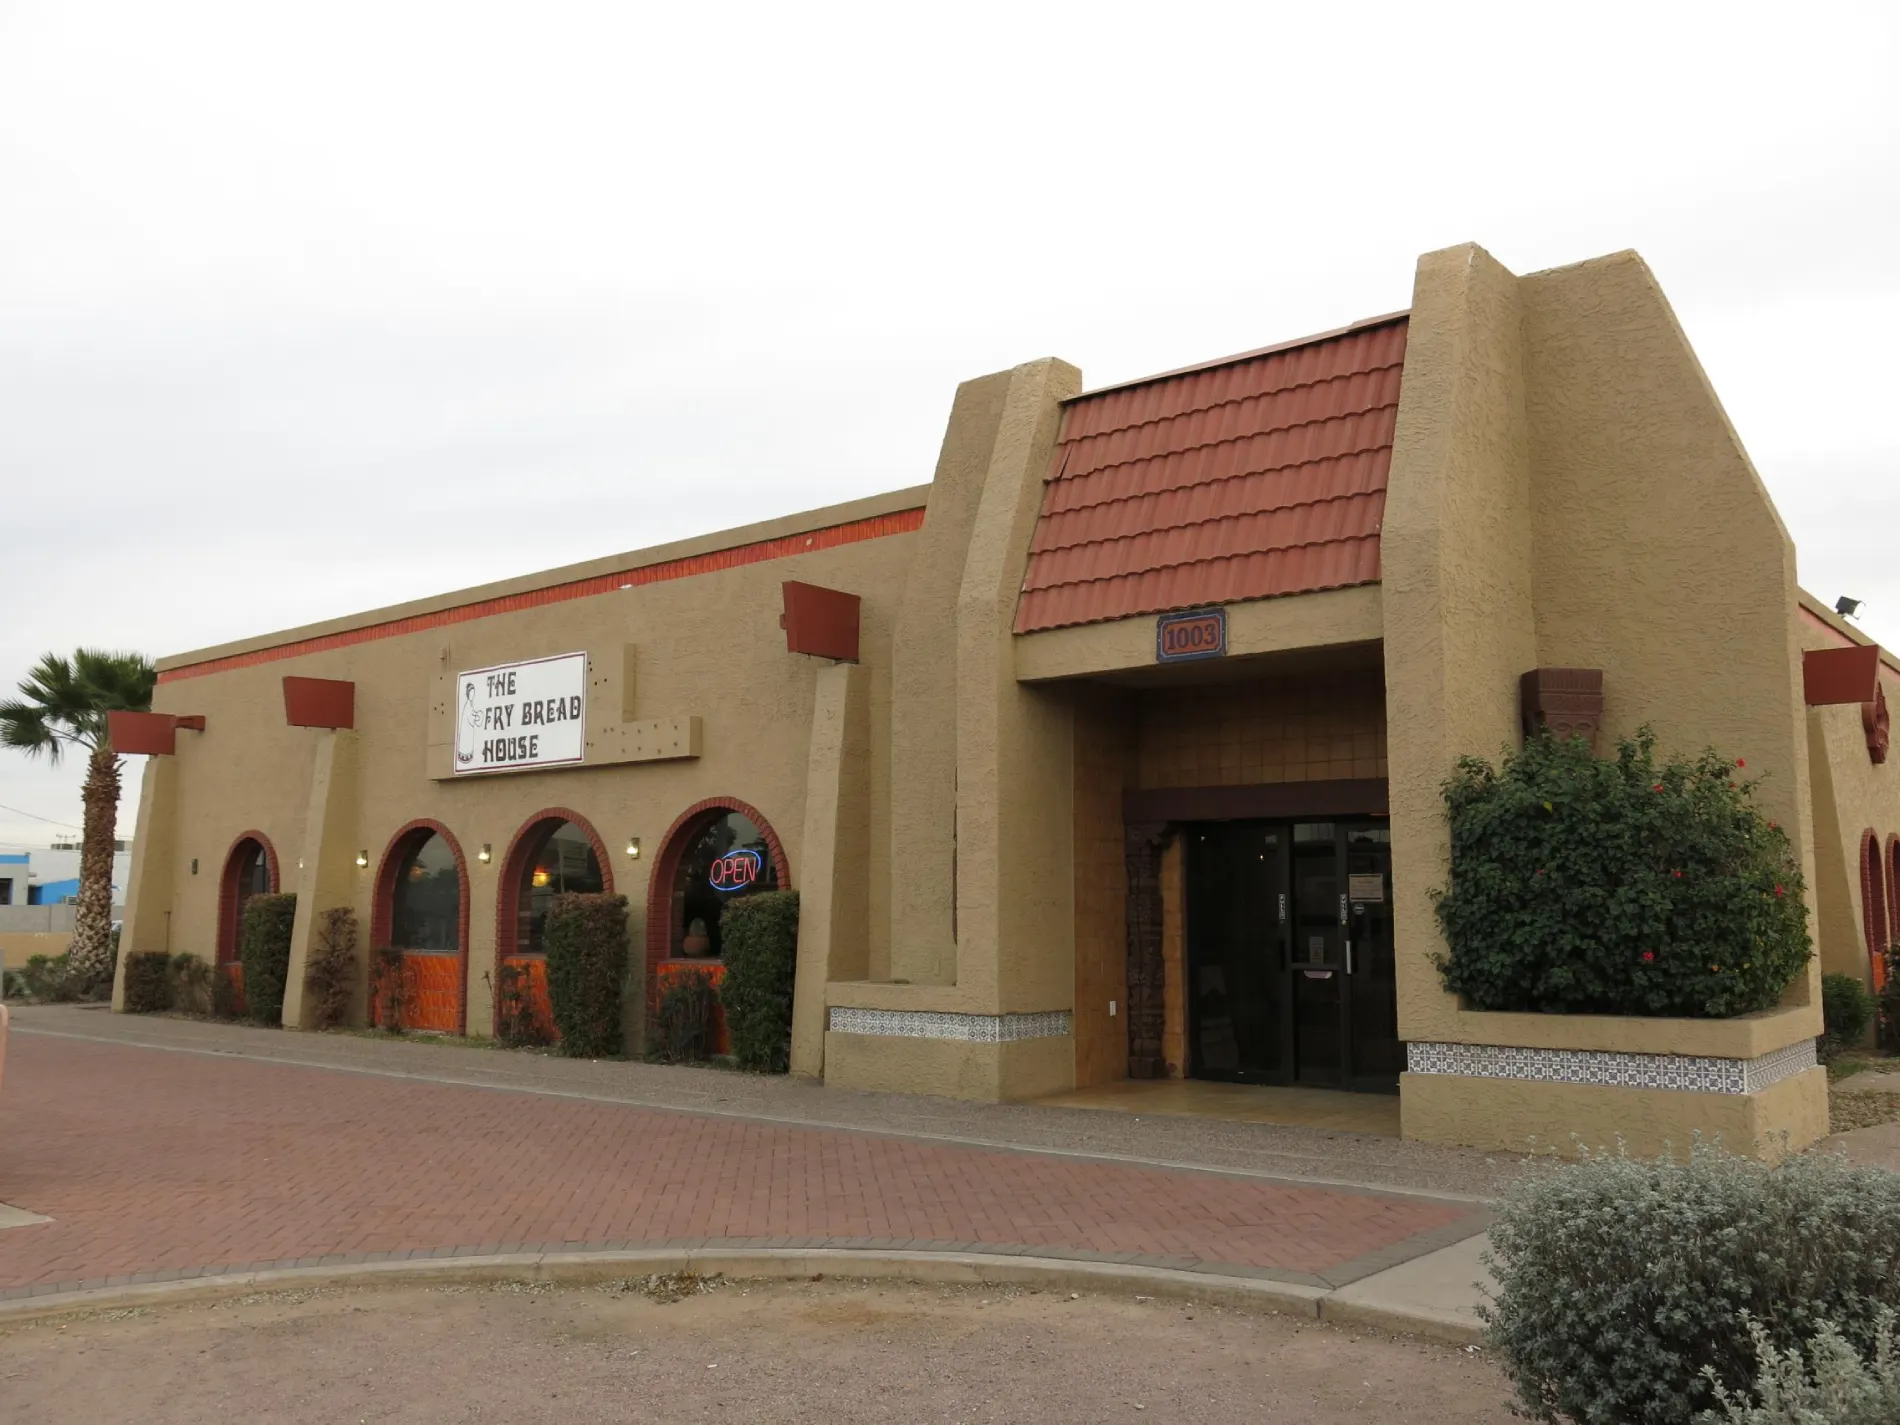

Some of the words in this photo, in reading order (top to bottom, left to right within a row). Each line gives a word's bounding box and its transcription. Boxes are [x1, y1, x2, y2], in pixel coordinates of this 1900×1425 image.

[1167, 624, 1217, 649] 1003
[487, 671, 517, 698] THE
[484, 703, 515, 730] FRY
[521, 695, 582, 726] BREAD
[482, 734, 539, 763] HOUSE
[711, 857, 757, 884] OPEN
